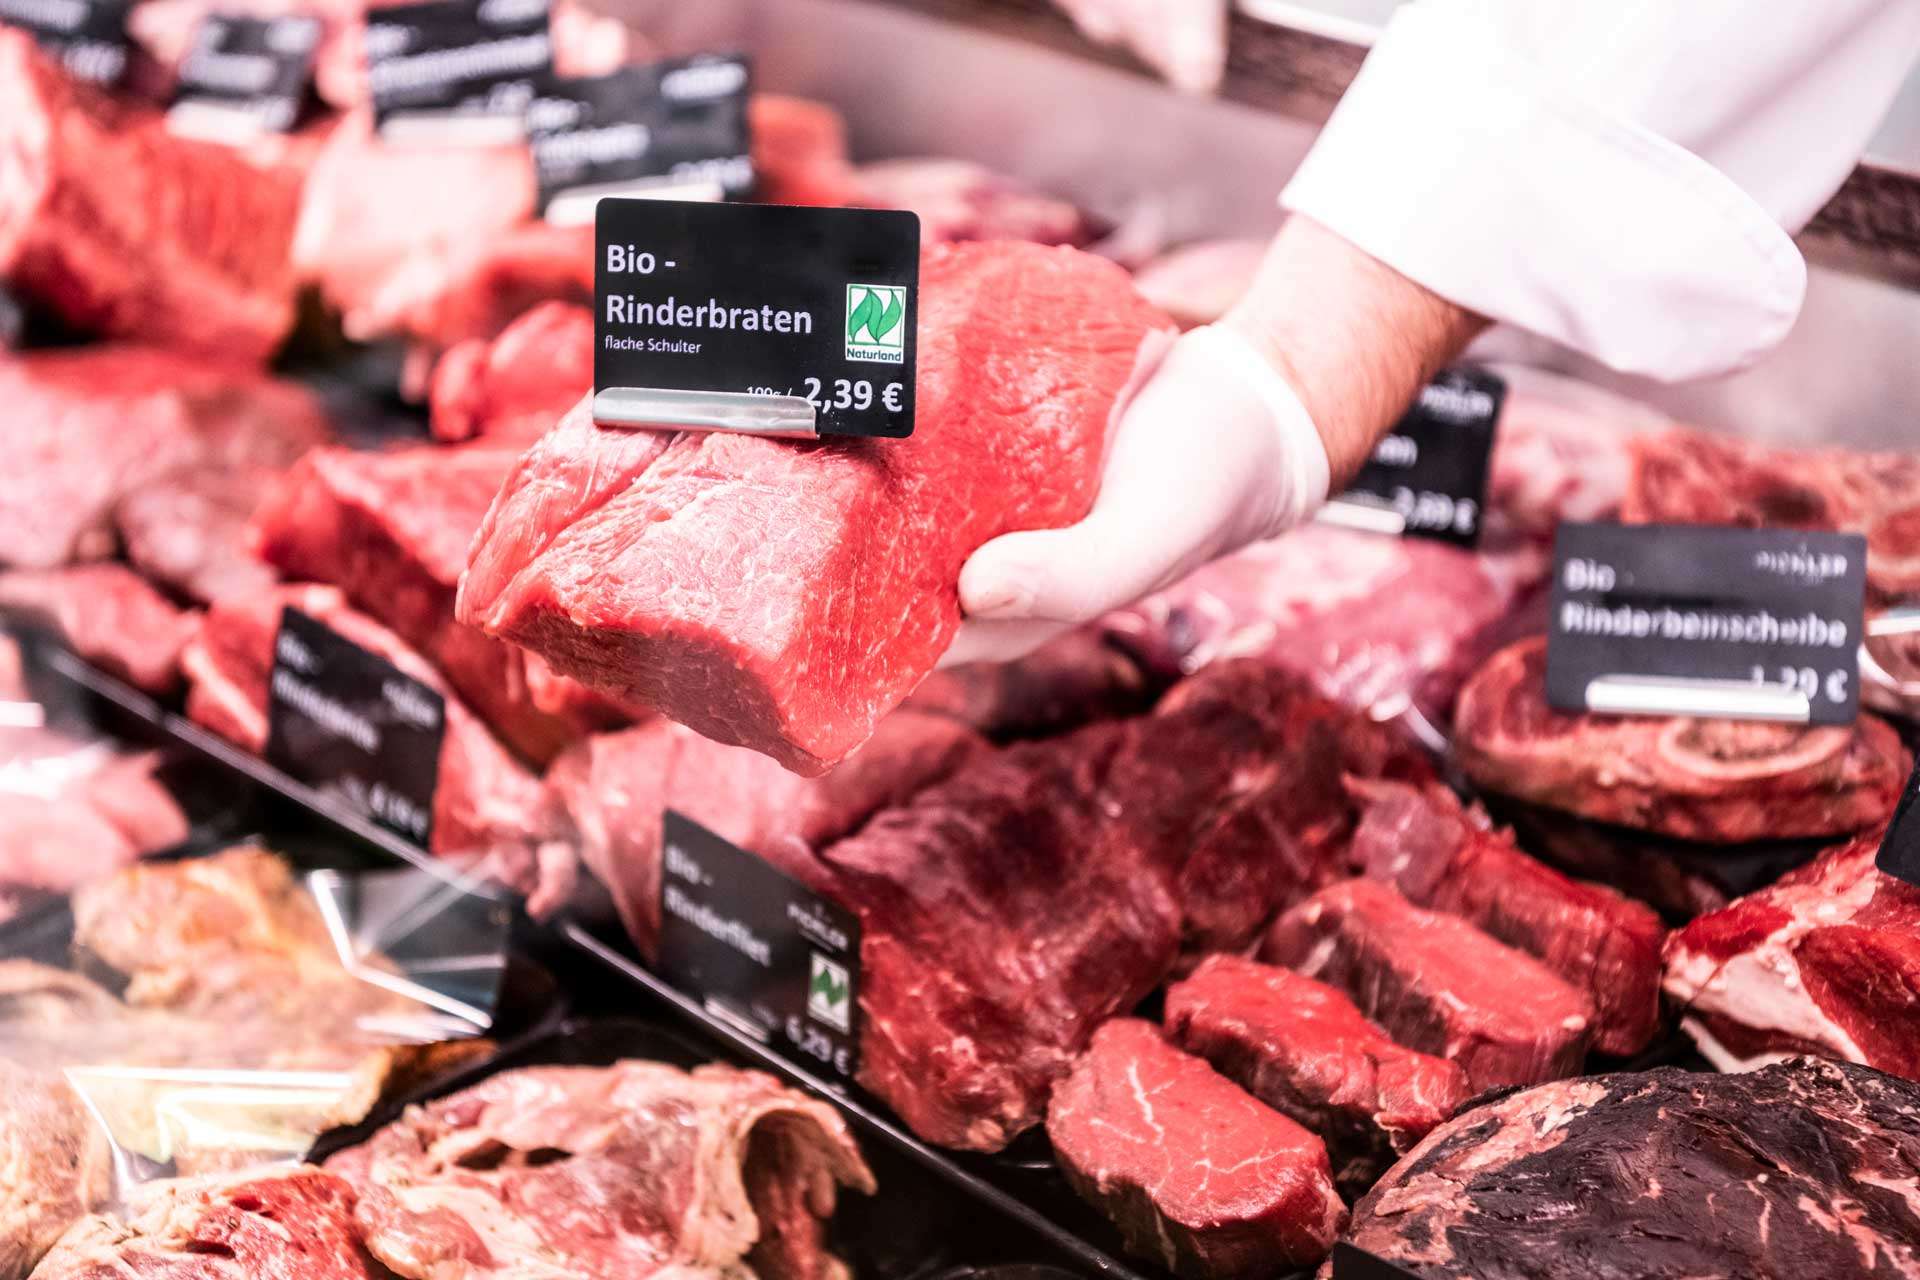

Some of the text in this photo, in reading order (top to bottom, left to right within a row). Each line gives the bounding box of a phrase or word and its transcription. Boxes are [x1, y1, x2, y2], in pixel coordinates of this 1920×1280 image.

[606, 244, 655, 274] Bio
[605, 295, 812, 334] Rinderbraten
[604, 335, 701, 354] flache Schulter
[846, 348, 902, 362] Naturland
[804, 377, 872, 414] 2,39
[882, 382, 903, 412] €
[1562, 557, 1616, 592] Bio
[1560, 601, 1848, 648] Rinderbeinscheibe
[1825, 668, 1849, 704] €
